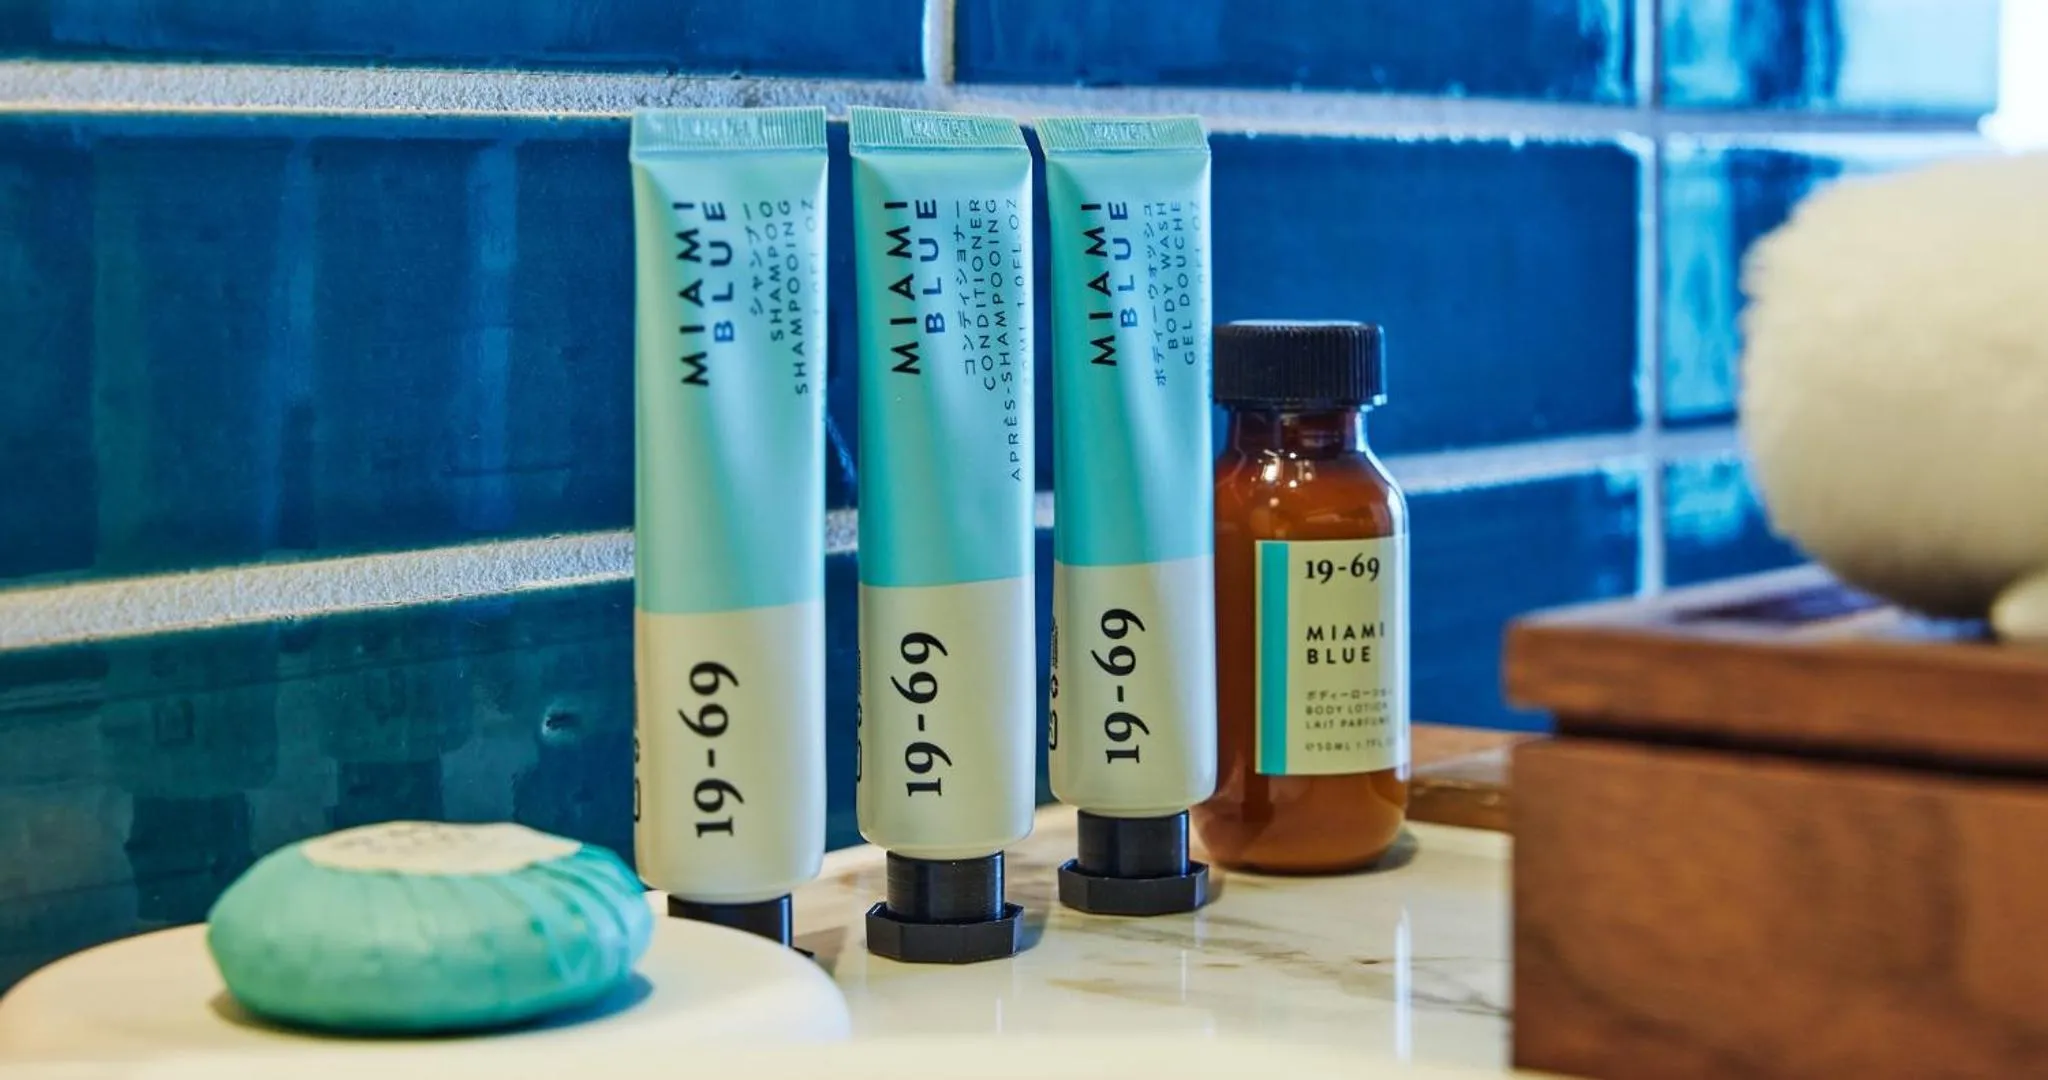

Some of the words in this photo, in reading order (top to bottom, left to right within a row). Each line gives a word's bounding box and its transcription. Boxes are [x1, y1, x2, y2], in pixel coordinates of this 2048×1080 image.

[672, 202, 710, 388] MIAMI
[702, 201, 735, 343] BLUE
[743, 202, 764, 316] シャンプー
[758, 201, 784, 343] SHAMPOO
[778, 200, 809, 396] SHAMPOOING
[884, 200, 921, 376] MIAMI
[916, 199, 946, 334] BLUE
[953, 200, 976, 376] コンディショナー
[969, 199, 996, 392] CONDITIONER
[1081, 203, 1117, 367] MIAMI
[1108, 201, 1138, 328] BLUE
[1156, 202, 1171, 270] WASH
[1170, 200, 1191, 307] DOUCHE
[985, 199, 1021, 482] APRÈS-SHAMPOOING
[1163, 283, 1179, 350] BODY
[1183, 319, 1196, 366] GEL
[1305, 553, 1381, 585] 19-69
[1306, 622, 1385, 642] MIAMI
[890, 631, 953, 798] 19-69
[1090, 607, 1151, 765] 19-69
[1305, 704, 1342, 716] BODY
[1305, 718, 1334, 730] LAIT
[1306, 646, 1372, 665] BLUE
[678, 660, 745, 839] 19-69
